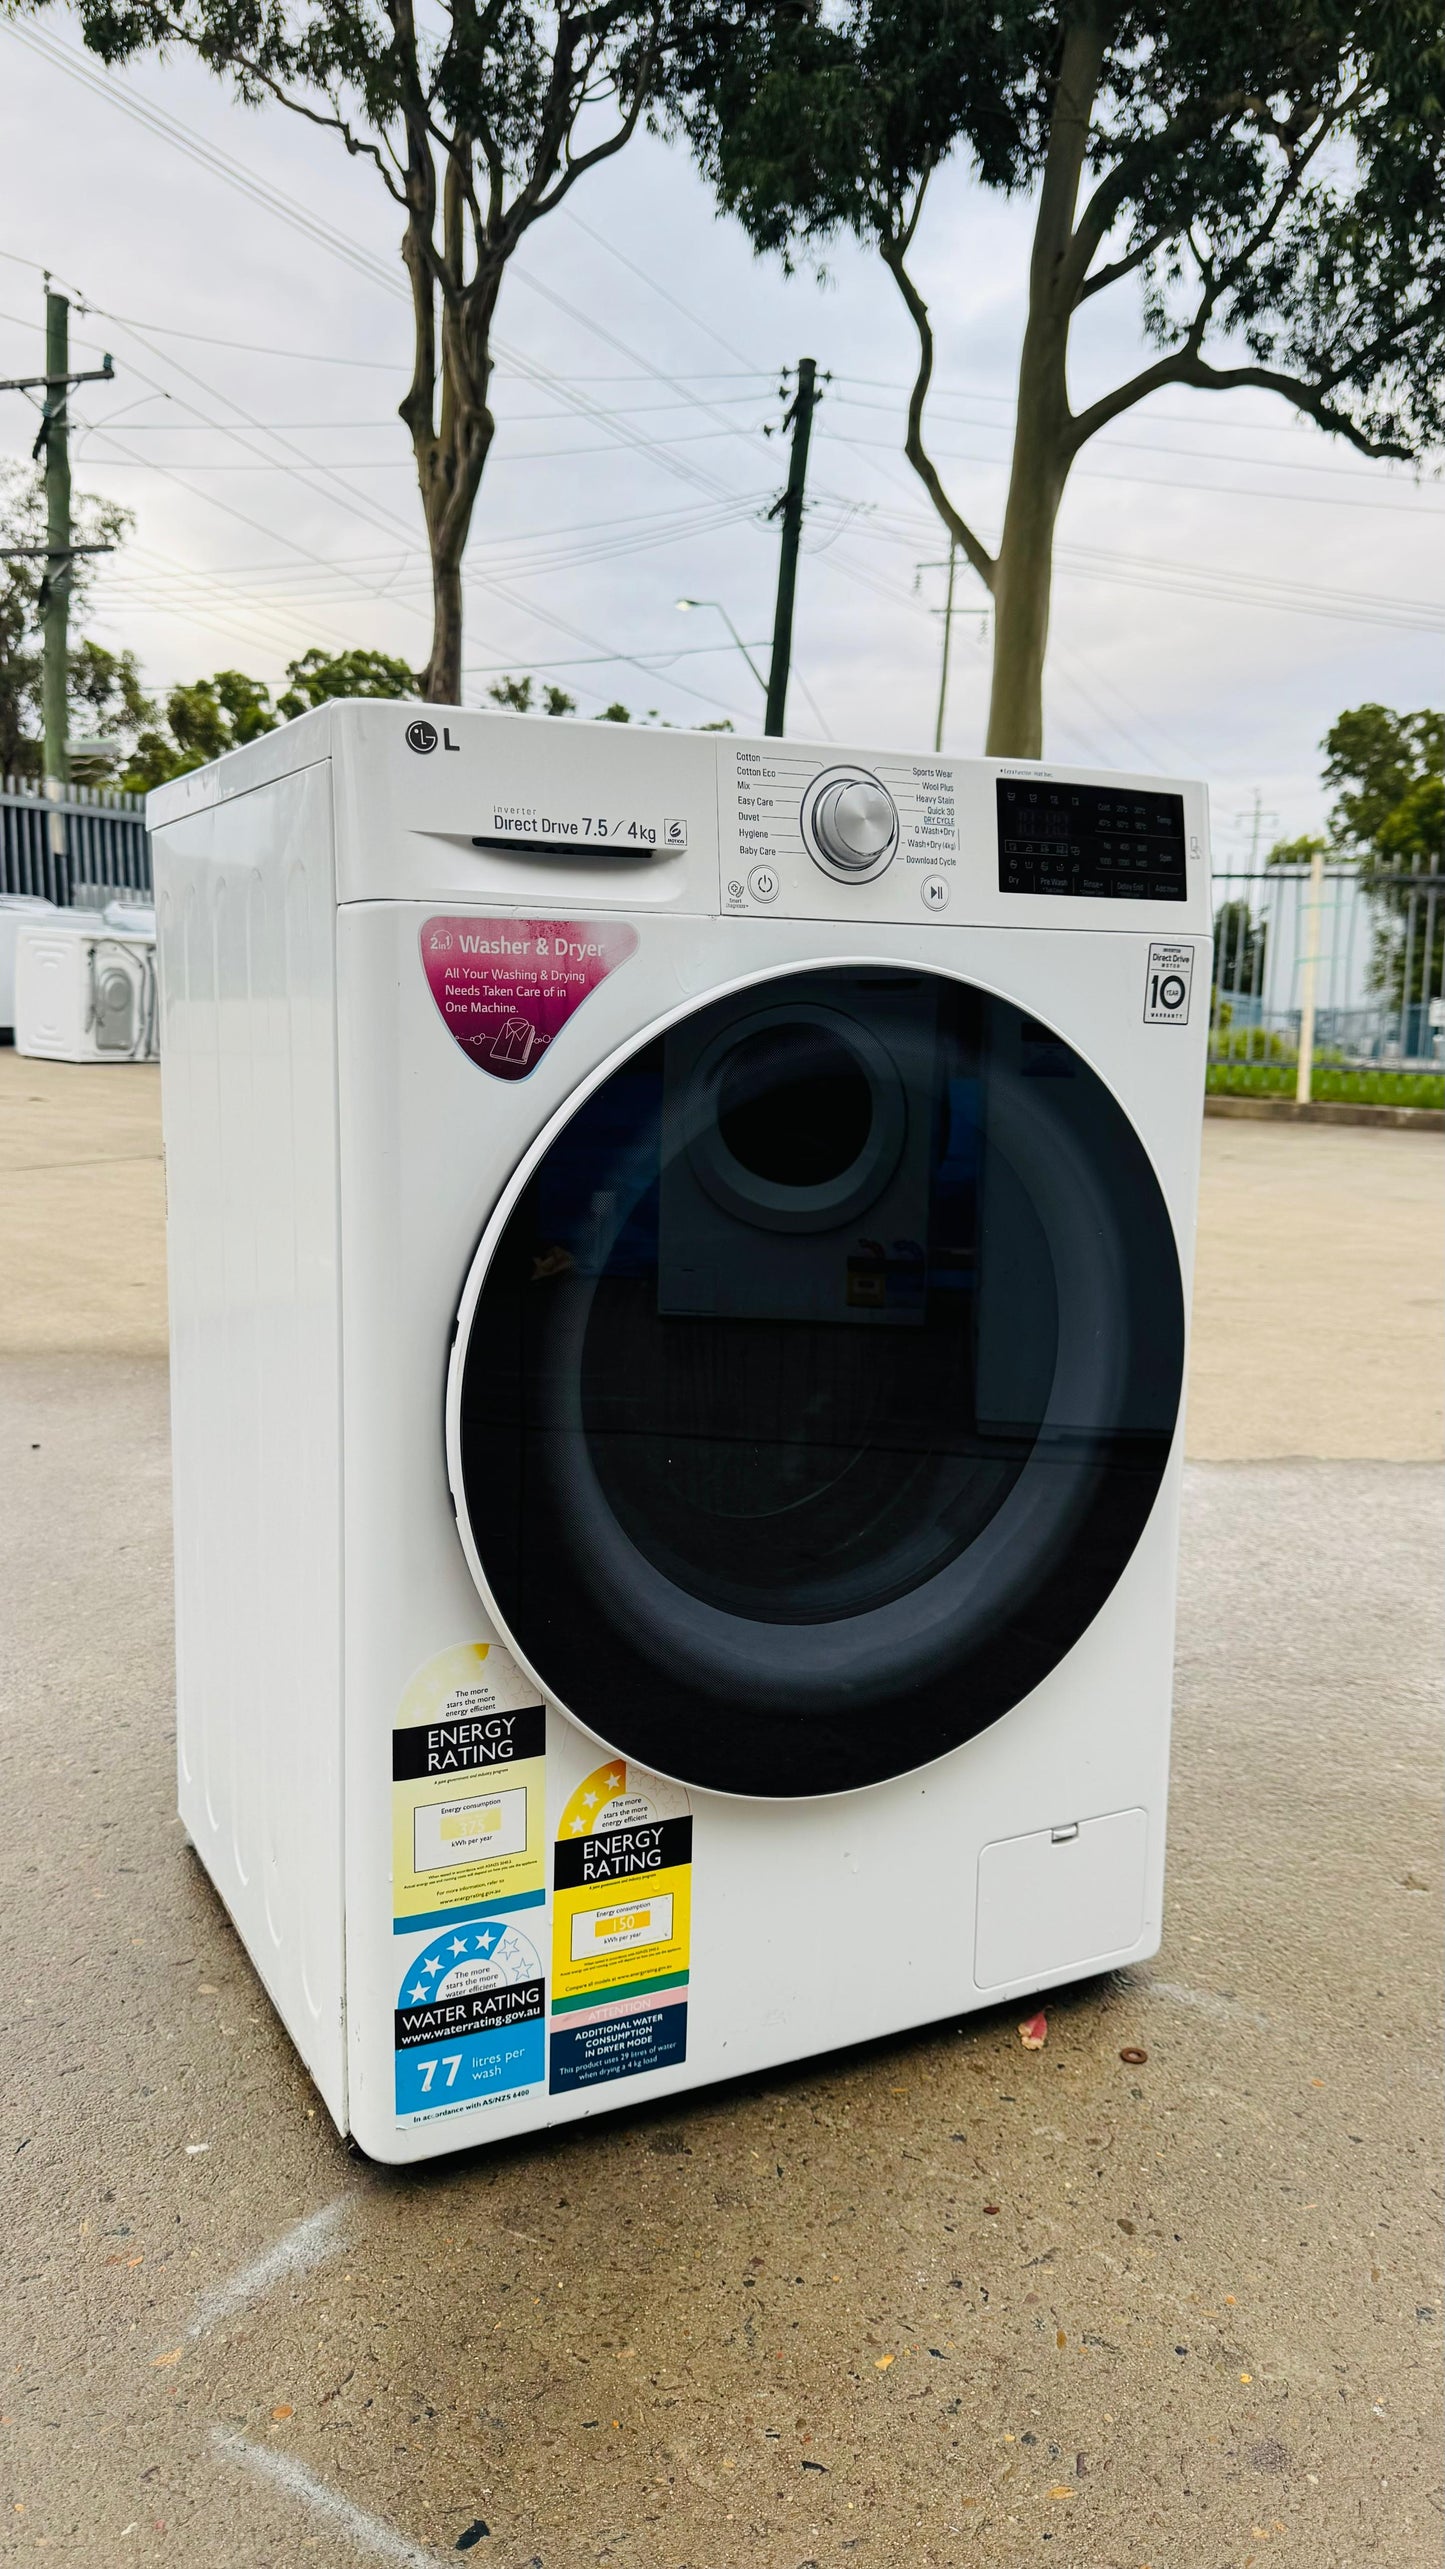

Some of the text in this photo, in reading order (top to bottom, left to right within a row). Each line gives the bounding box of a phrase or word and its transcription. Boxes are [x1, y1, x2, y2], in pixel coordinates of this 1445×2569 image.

[736, 752, 761, 763] Cotton
[736, 766, 776, 778] Cotton Eco
[912, 767, 953, 779] Sports Wear
[737, 781, 750, 790] Mix
[921, 782, 954, 793] Wool Plus
[738, 796, 774, 808] Easy Care
[915, 794, 955, 806] Heavy Stain
[493, 805, 537, 816] Inverter
[738, 812, 760, 822] Duvet
[927, 806, 955, 816] Quick 30
[936, 817, 955, 825] CYCLE
[493, 814, 538, 833] Direct
[541, 818, 578, 836] Drive
[581, 818, 608, 837] 7.5
[627, 821, 657, 844] 4kg
[739, 829, 769, 840] Hygiene
[920, 825, 955, 838] Wash+Dry
[739, 846, 777, 857] Baby Care
[907, 839, 942, 851] Wash+Dry
[906, 856, 957, 868] Download Cycle
[459, 935, 605, 961] Washer & Dryer
[1152, 953, 1190, 964] Direct Drive
[445, 968, 585, 984] All Your Washing & Drying
[445, 985, 567, 997] Needs Taken Care of in
[1151, 975, 1186, 1010] 10
[445, 1002, 519, 1013] One Machine.
[455, 1687, 489, 1698] The more
[446, 1695, 496, 1709] stars the more
[445, 1703, 496, 1718] energy efficient
[428, 1716, 517, 1750] ENERGY
[428, 1739, 514, 1772] RATING
[441, 1799, 502, 1815] Energy consumption
[611, 1798, 642, 1809] The more
[603, 1806, 649, 1820] stars the more
[601, 1813, 648, 1828] energy efficient
[451, 1835, 493, 1848] kWh per year
[583, 1827, 664, 1860] ENERGY
[583, 1849, 662, 1881] RATING
[596, 1901, 651, 1918] Energy consumption
[613, 1915, 635, 1932] 150
[603, 1932, 642, 1944] kWh per year
[470, 1967, 491, 1976] more
[446, 1973, 499, 1990] stars the more
[565, 1980, 587, 1992] Compare
[445, 1982, 497, 1999] water efficient
[402, 1987, 540, 2031] WATER RATING
[588, 1999, 653, 2022] ATTENTION
[401, 2006, 540, 2045] www.waterrating.gov.au
[575, 2013, 663, 2041] ADDITIONAL WATER
[585, 2026, 653, 2048] CONSUMPTION
[585, 2035, 653, 2059] IN DRYER MODE
[472, 2048, 526, 2068] litres per
[560, 2042, 677, 2076] This product uses 29 litres of water
[417, 2053, 463, 2093] 77
[472, 2066, 502, 2081] wash
[578, 2071, 598, 2081] when
[599, 2066, 621, 2077] drying
[633, 2059, 642, 2068] kg
[643, 2055, 658, 2065] load
[465, 2101, 482, 2111] with
[482, 2094, 512, 2107] AS/NZS
[512, 2089, 530, 2099] 6400
